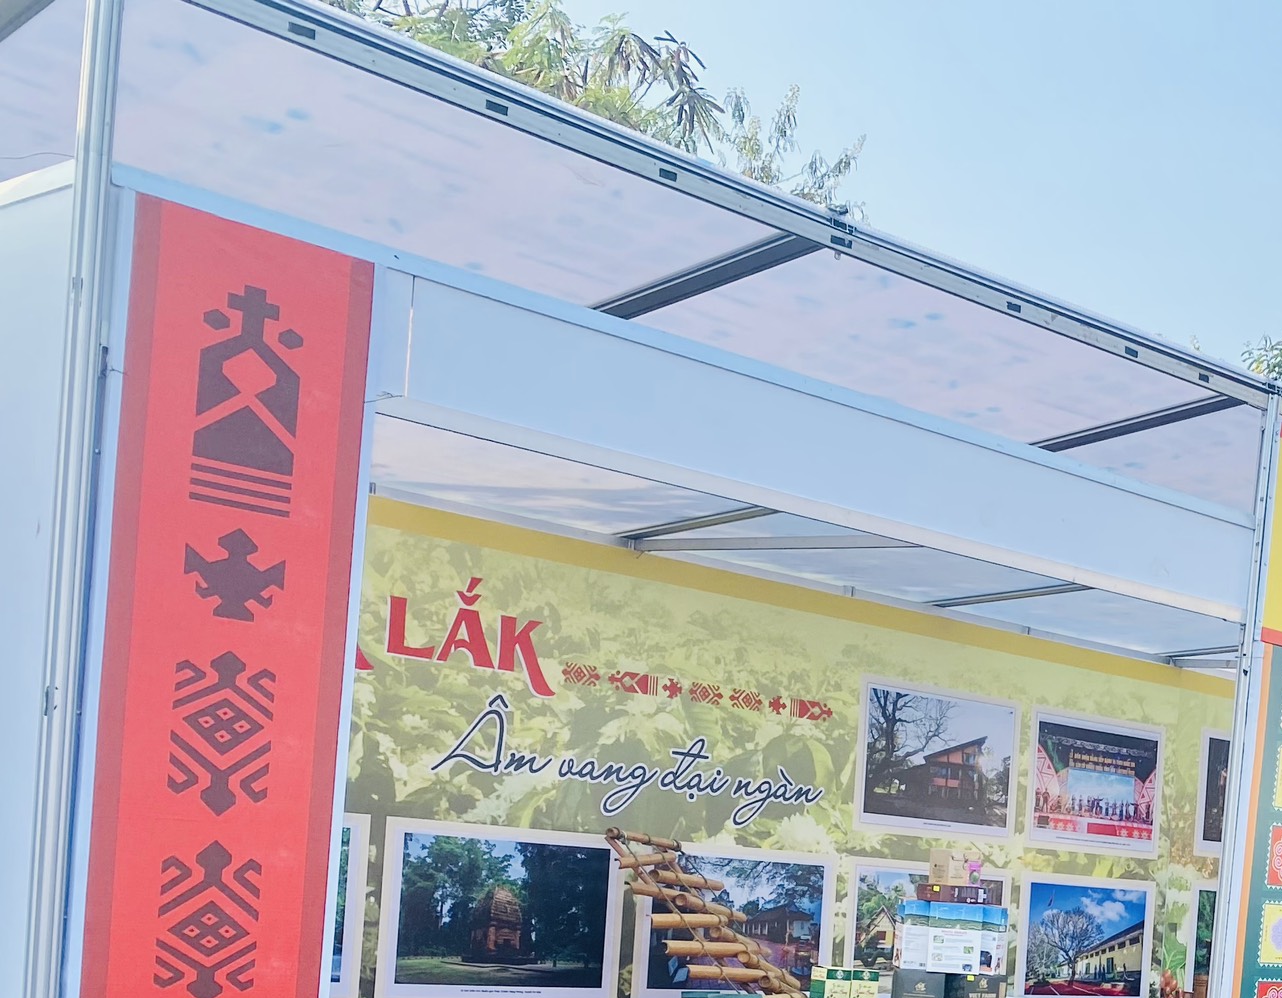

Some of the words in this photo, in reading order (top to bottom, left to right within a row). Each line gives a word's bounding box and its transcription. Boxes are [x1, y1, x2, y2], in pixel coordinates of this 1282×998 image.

[386, 576, 557, 697] LẮK
[430, 693, 554, 774] Âm
[557, 757, 659, 815] vang
[661, 738, 729, 804] đại
[730, 765, 825, 827] ngàn
